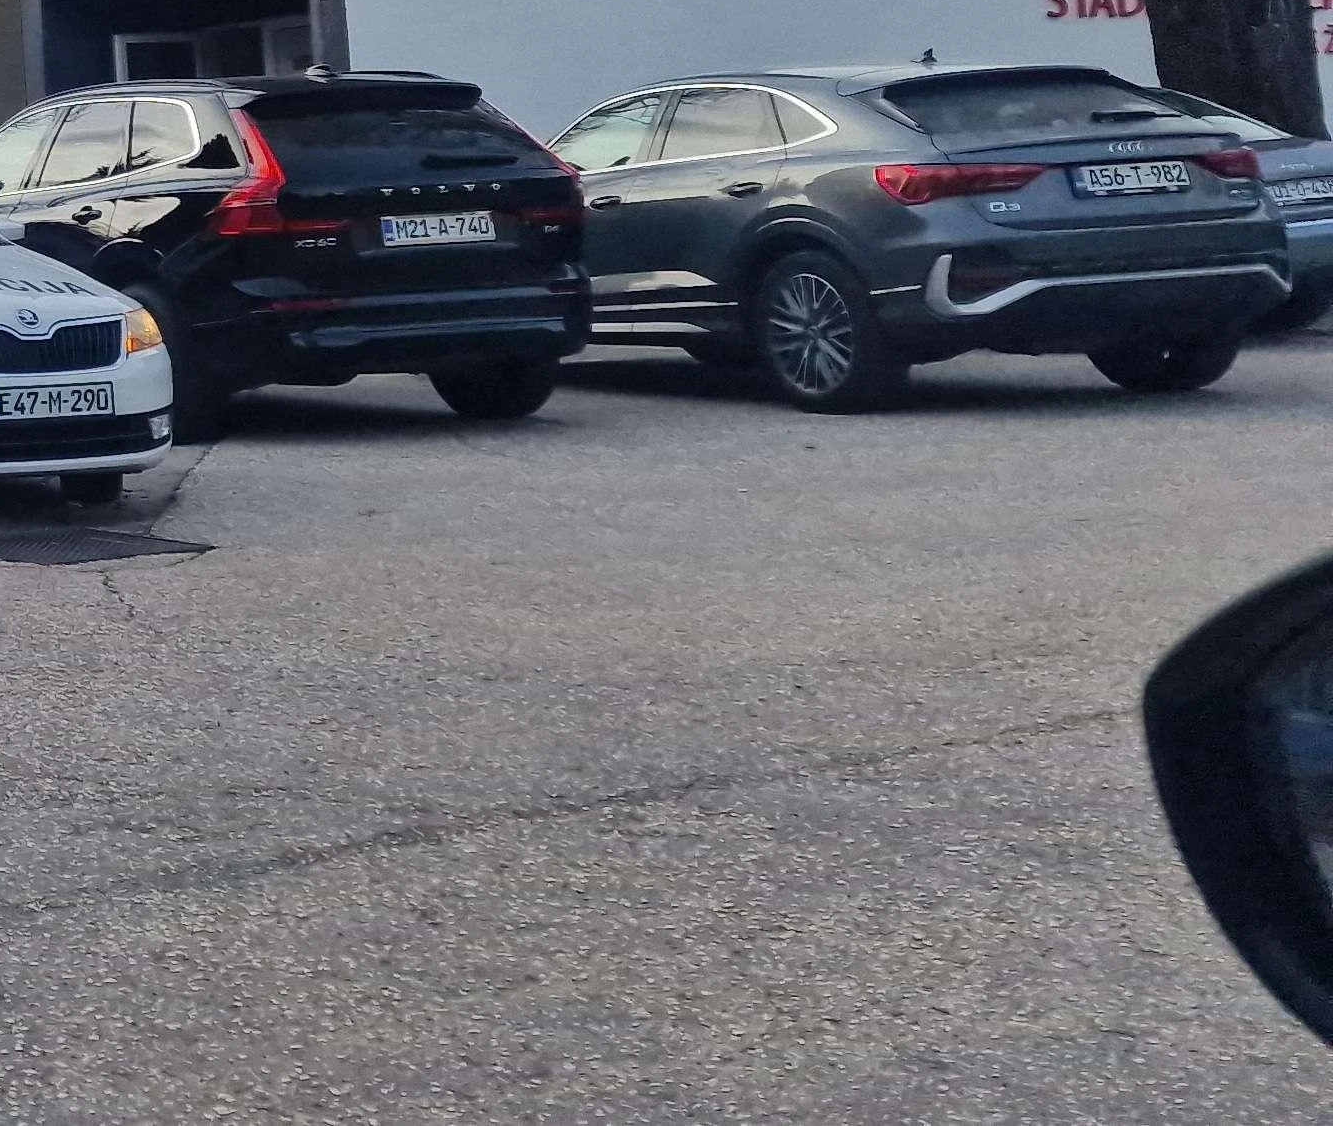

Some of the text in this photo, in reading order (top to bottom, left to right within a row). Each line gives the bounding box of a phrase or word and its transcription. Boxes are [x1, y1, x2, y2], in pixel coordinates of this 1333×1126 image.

[1089, 164, 1187, 188] A56-T-982
[380, 183, 502, 196] VOLVO
[395, 216, 490, 239] M21-A-740
